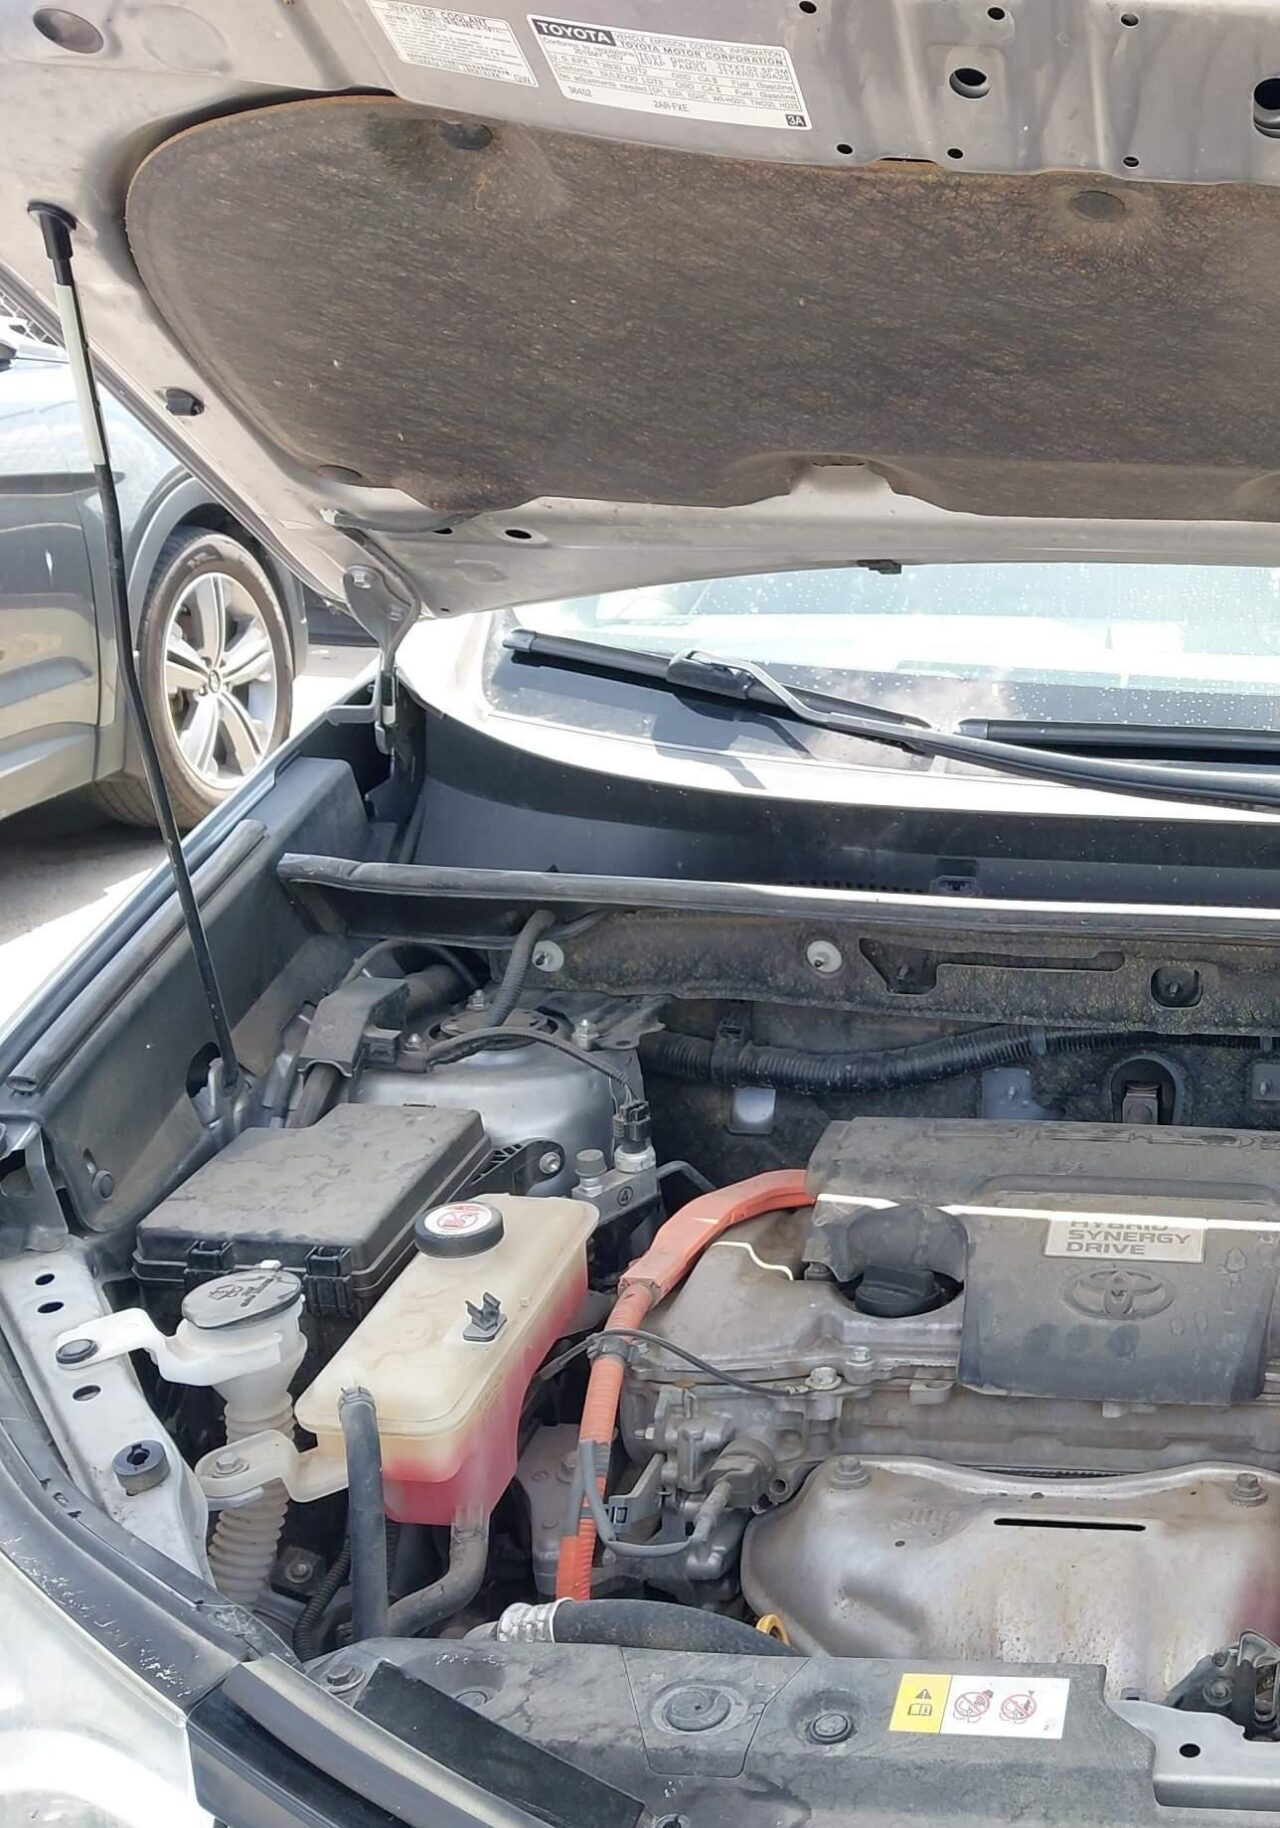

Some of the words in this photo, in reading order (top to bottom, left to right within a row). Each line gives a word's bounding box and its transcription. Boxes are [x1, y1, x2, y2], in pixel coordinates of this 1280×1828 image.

[537, 22, 611, 43] TOYOTA
[620, 42, 661, 53] TOYOTA
[663, 47, 701, 57] MOTOR
[705, 52, 784, 66] CORPORATION
[788, 115, 805, 127] 3A
[1068, 1229, 1190, 1244] SYNERGY
[1066, 1241, 1145, 1255] DRIVE
